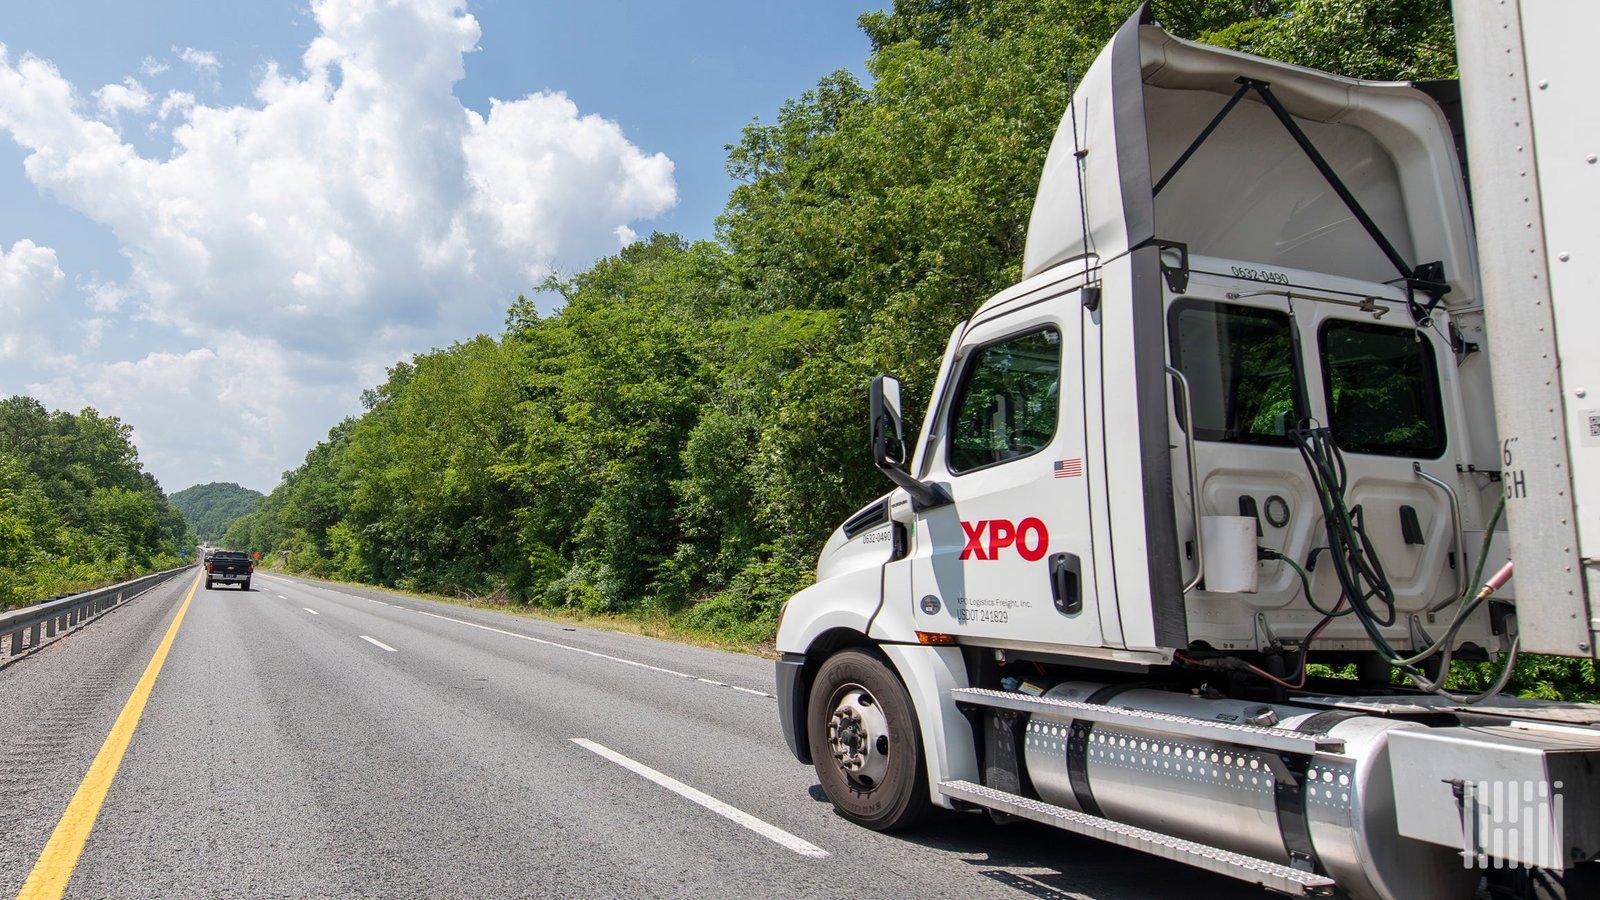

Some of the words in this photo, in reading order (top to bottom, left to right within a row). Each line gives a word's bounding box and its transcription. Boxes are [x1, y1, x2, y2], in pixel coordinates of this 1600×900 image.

[1231, 266, 1289, 285] 0632-0490
[863, 531, 891, 544] 0632-0490
[959, 517, 1049, 562] XPO
[957, 597, 968, 606] XPO
[969, 599, 995, 607] Logistics
[957, 608, 978, 621] USDOT
[980, 609, 1008, 623] 241829
